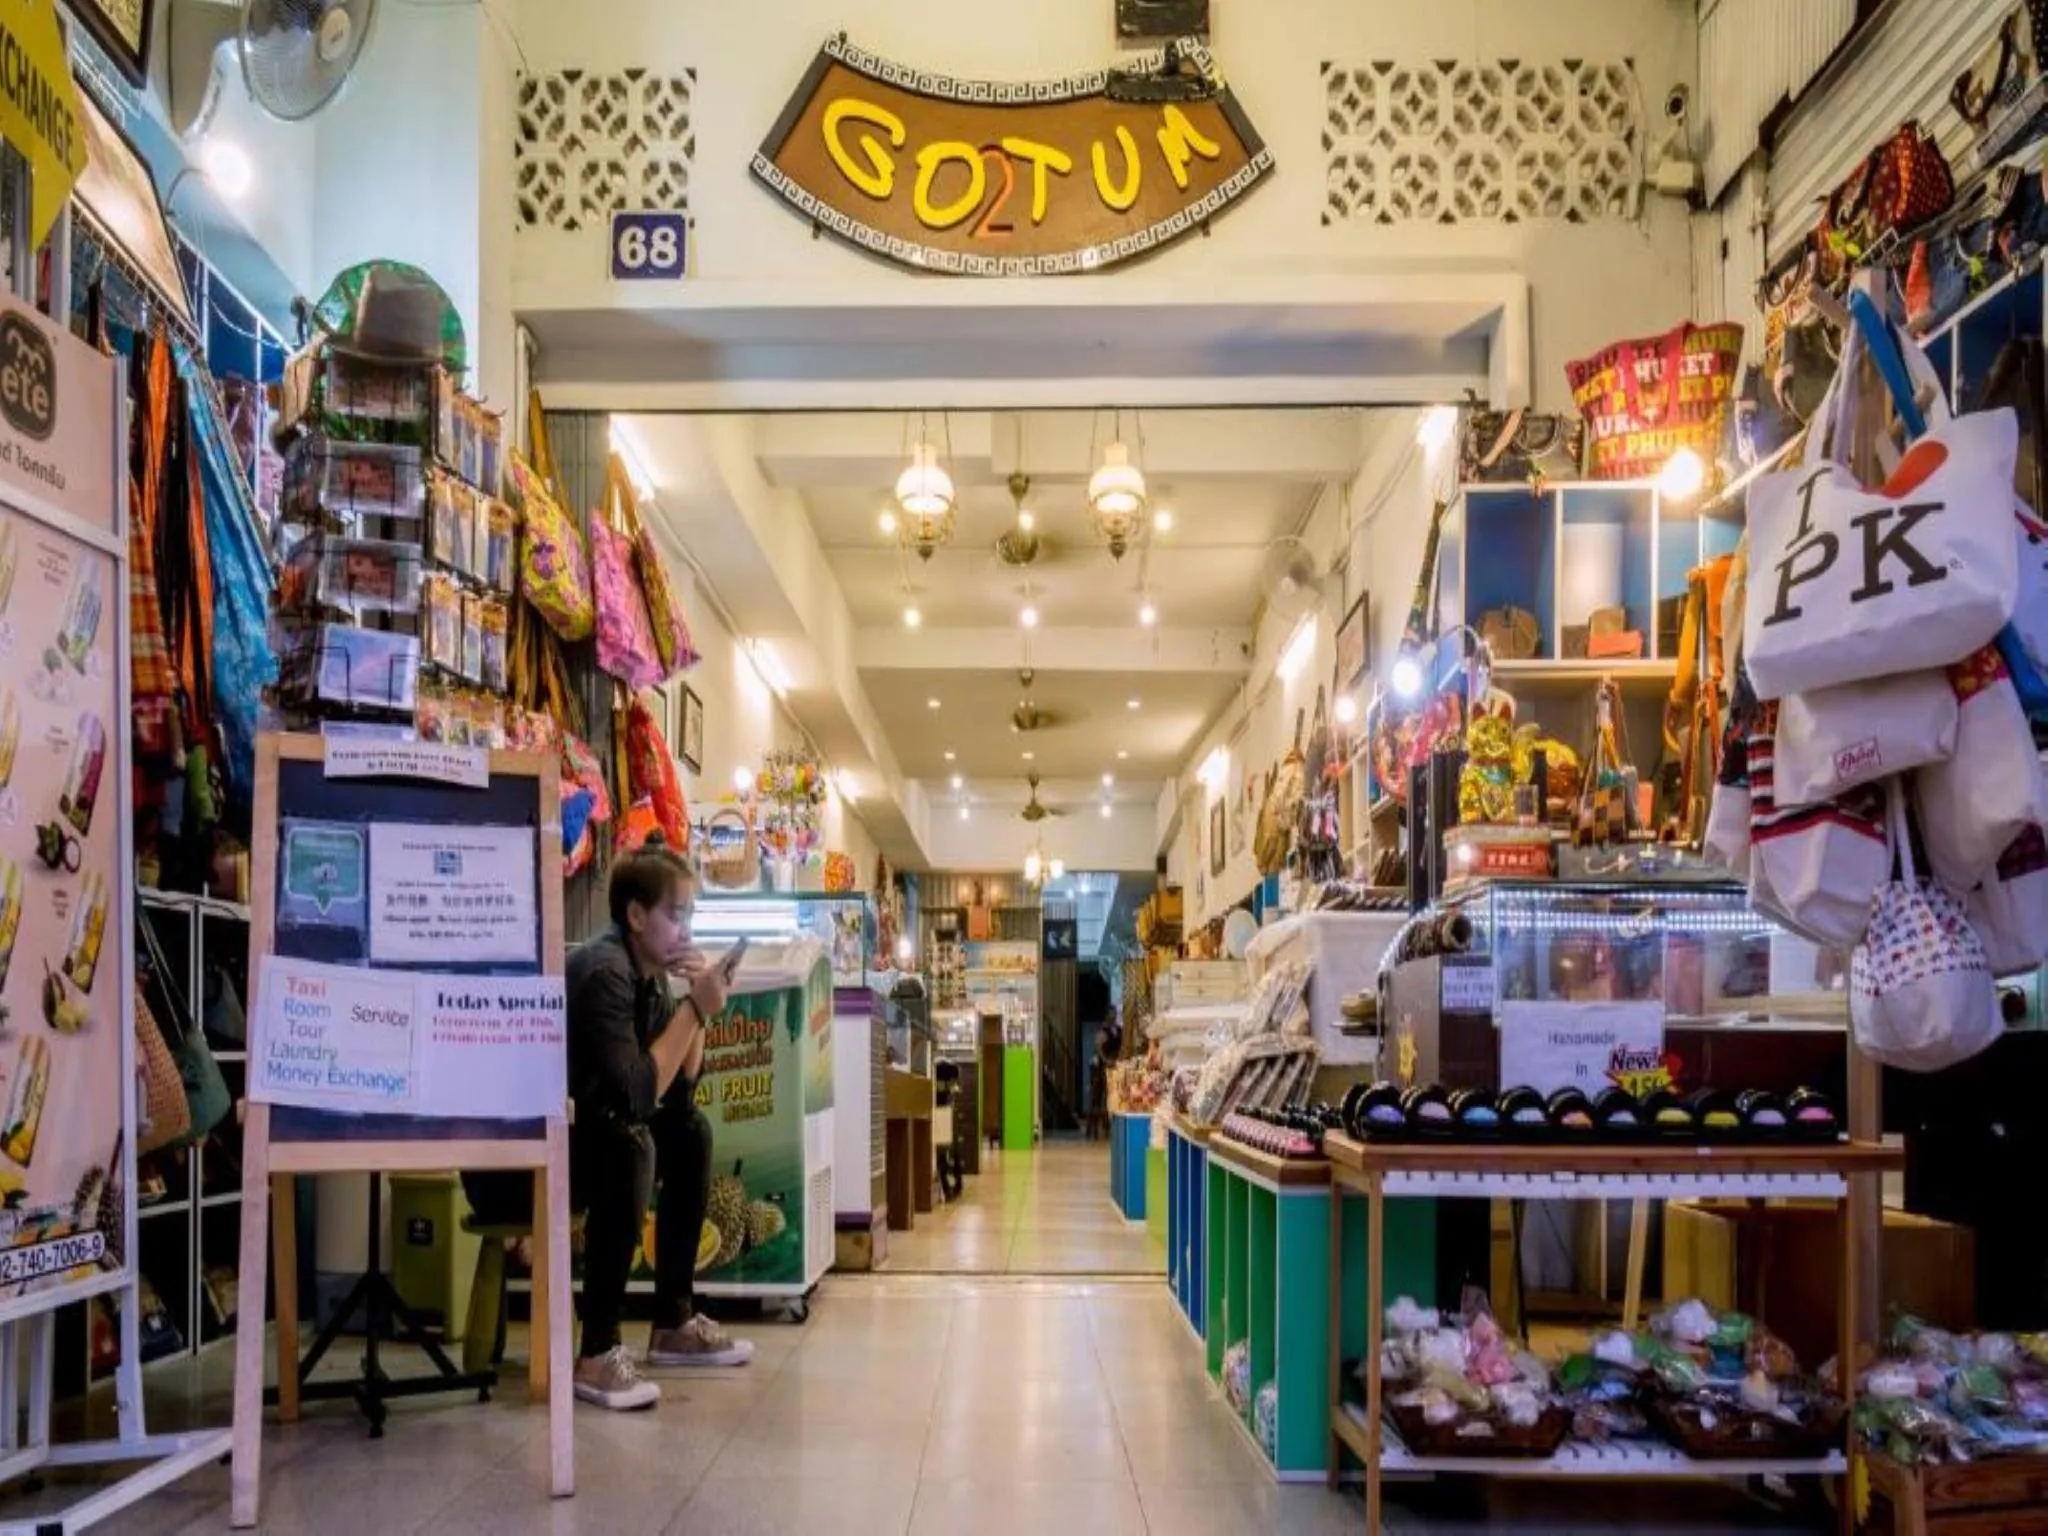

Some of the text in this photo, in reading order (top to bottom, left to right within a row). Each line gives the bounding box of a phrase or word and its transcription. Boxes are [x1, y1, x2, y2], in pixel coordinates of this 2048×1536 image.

[619, 225, 677, 269] 68
[1785, 467, 1832, 550] I
[1763, 502, 1947, 627] PK
[286, 976, 326, 998] Taxi
[284, 997, 331, 1017] Room
[350, 1003, 409, 1027] Service
[287, 1019, 326, 1039] Tour
[270, 1041, 338, 1065] Laundry
[267, 1061, 407, 1096] Money Exchange
[722, 1072, 773, 1102] FRUIT
